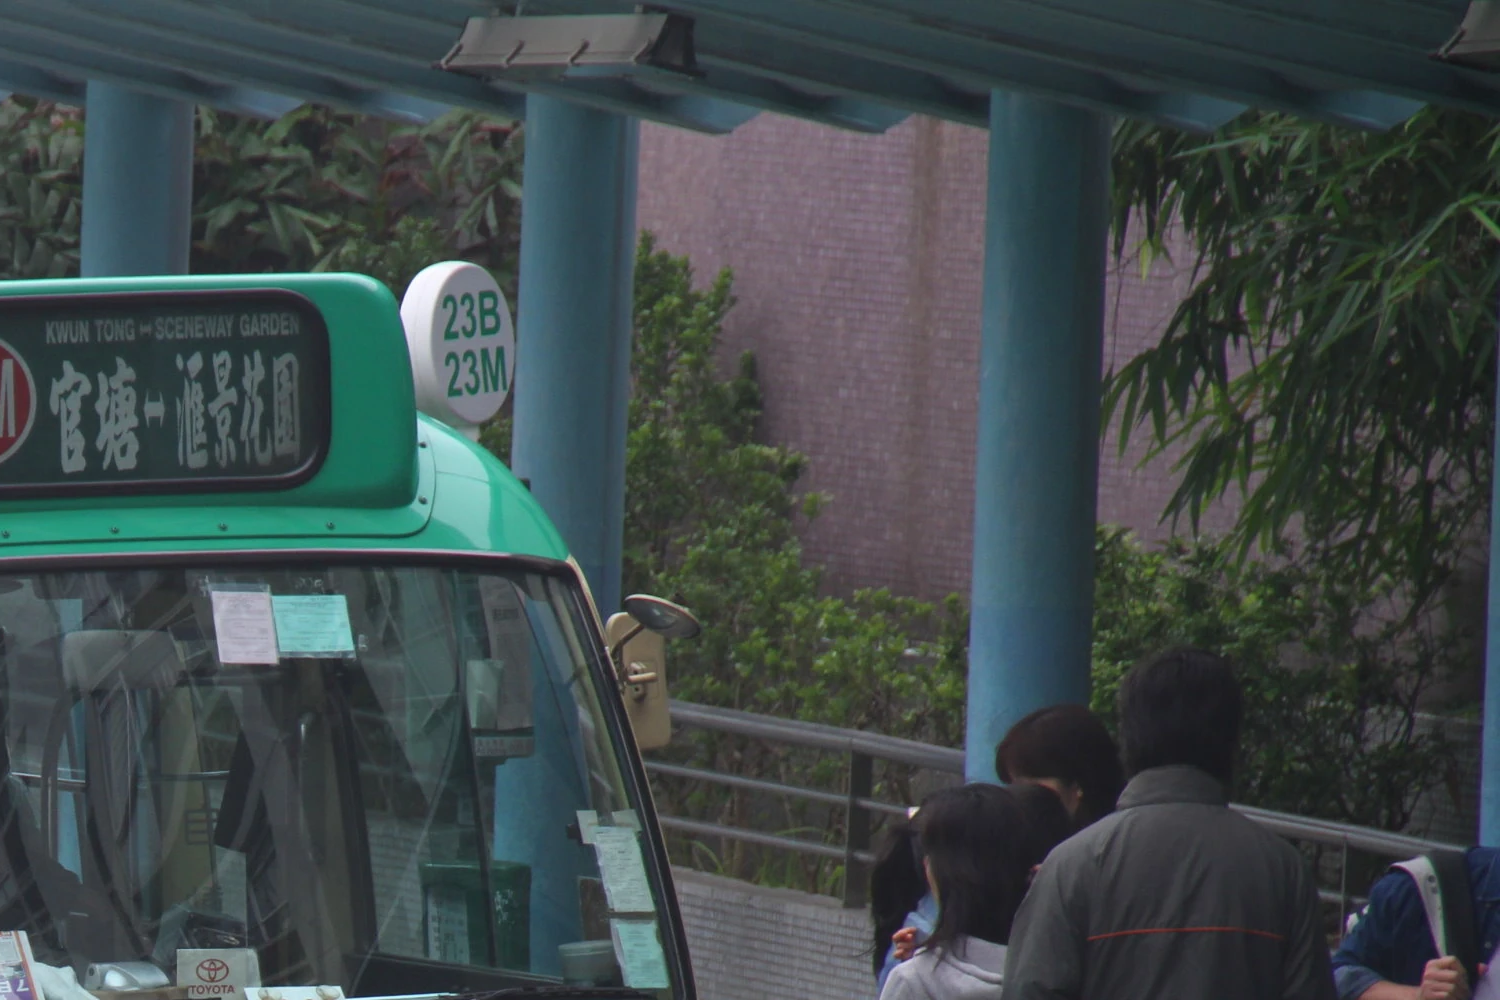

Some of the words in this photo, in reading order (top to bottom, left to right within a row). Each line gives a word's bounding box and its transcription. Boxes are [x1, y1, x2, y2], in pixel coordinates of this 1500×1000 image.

[45, 319, 89, 345] KWUN
[94, 317, 136, 342] TONG
[155, 315, 234, 340] SCENEWAY
[239, 313, 300, 337] GARDEN
[442, 290, 501, 341] 23B
[445, 346, 508, 398] 23M
[49, 356, 140, 474] 官塘
[189, 984, 236, 995] TOYOTA
